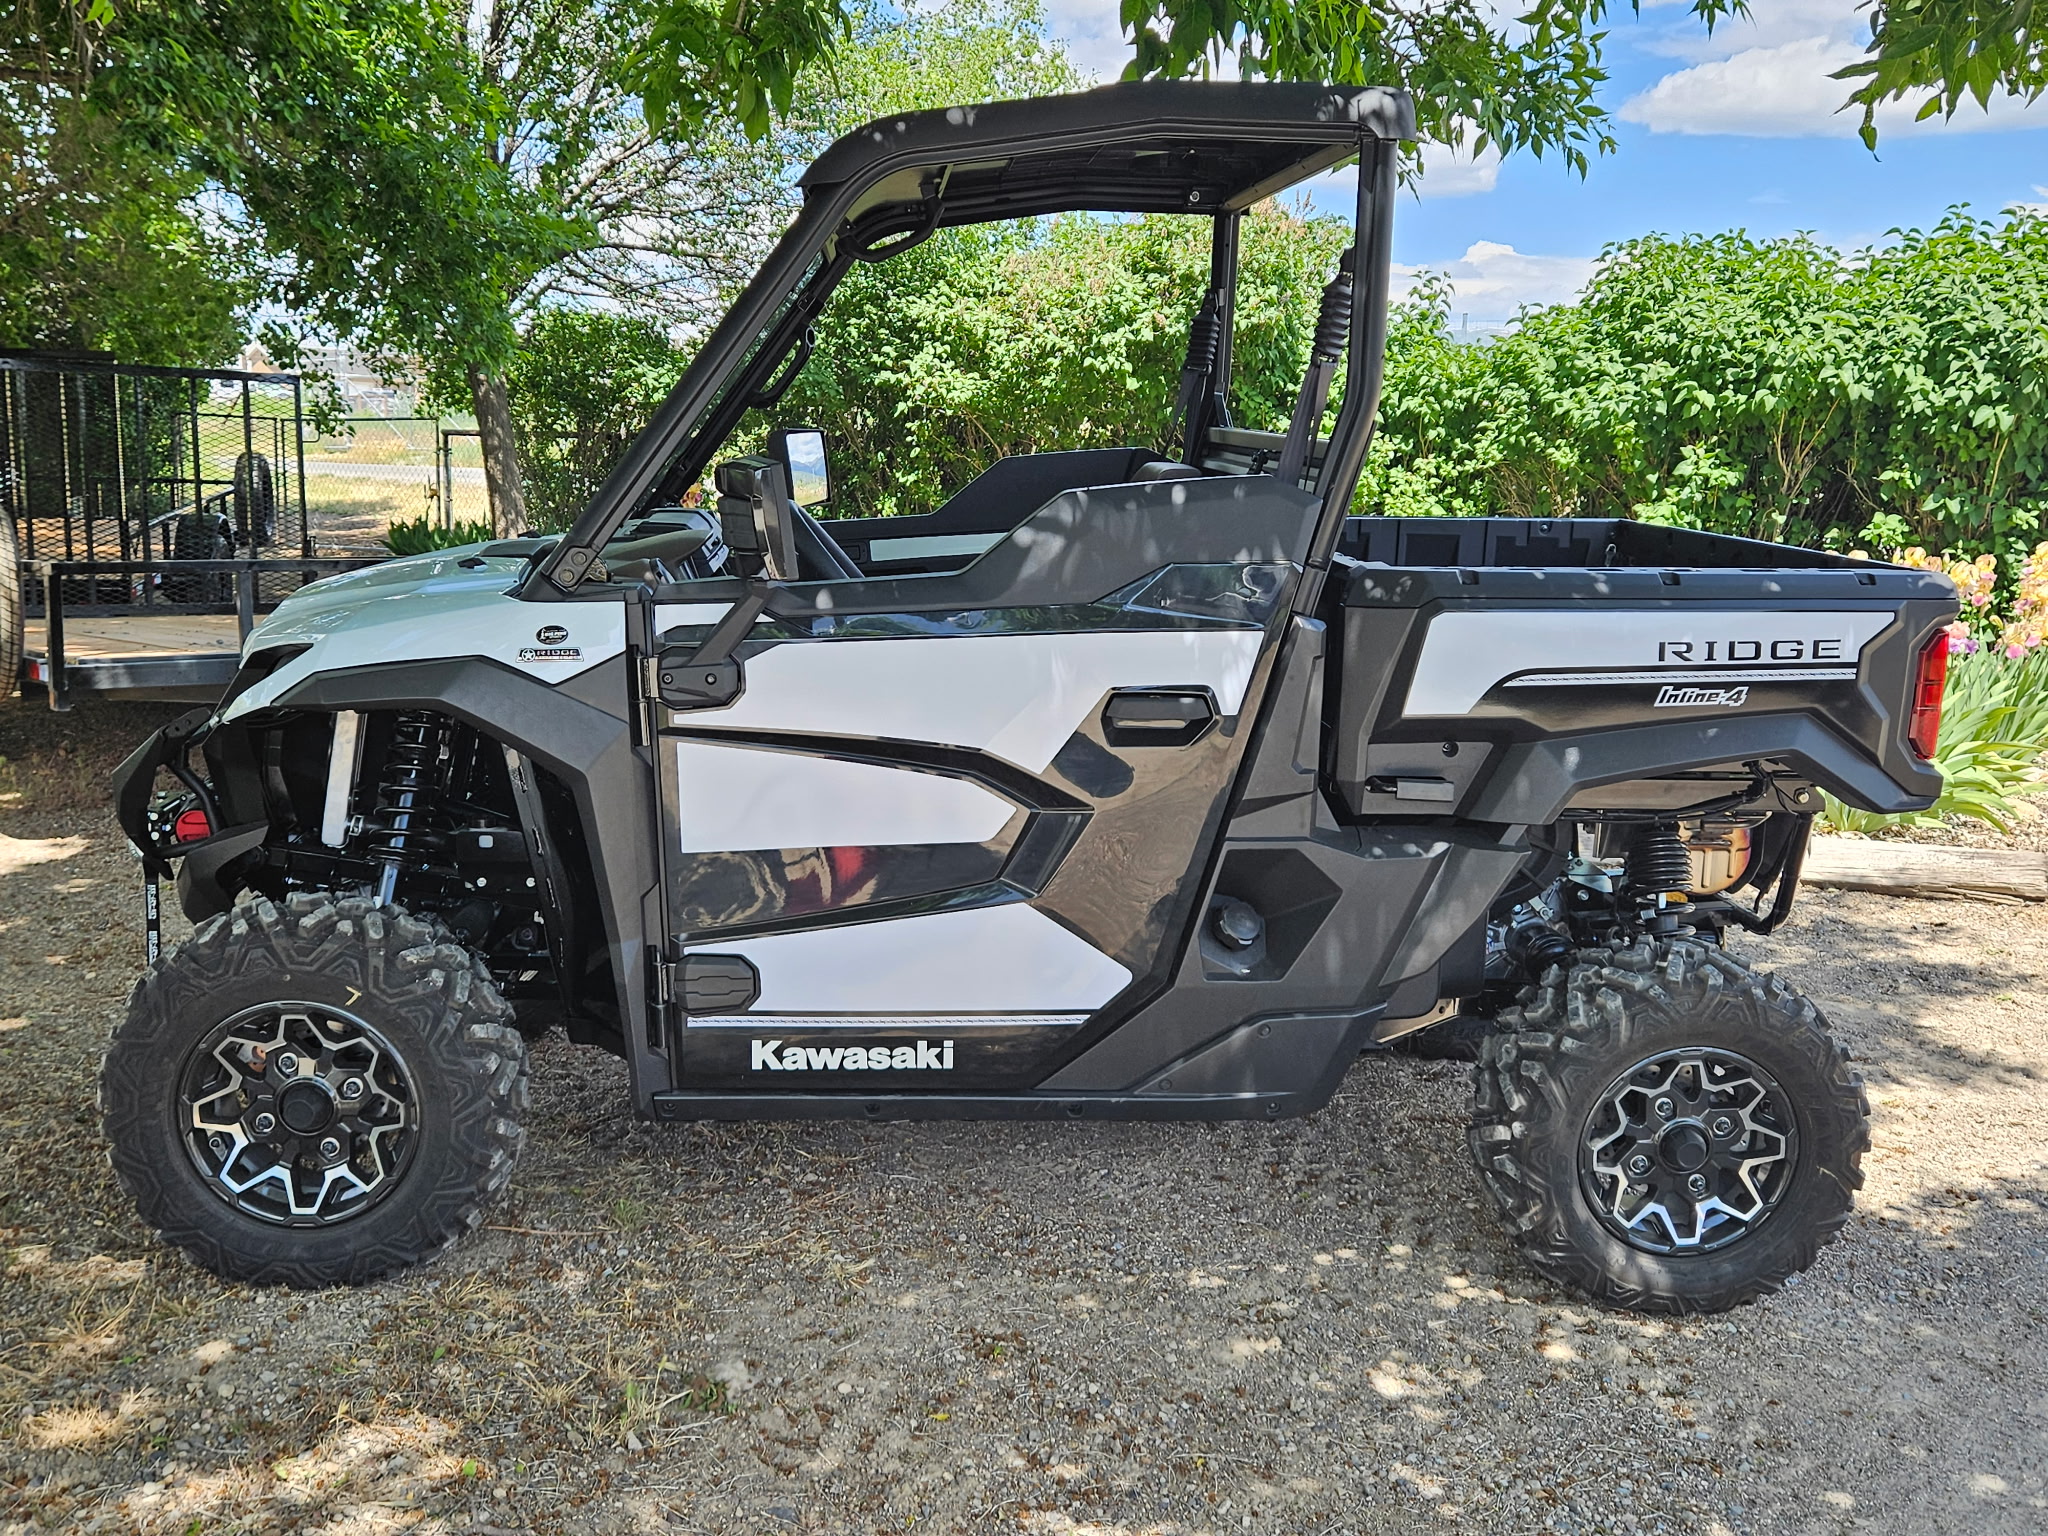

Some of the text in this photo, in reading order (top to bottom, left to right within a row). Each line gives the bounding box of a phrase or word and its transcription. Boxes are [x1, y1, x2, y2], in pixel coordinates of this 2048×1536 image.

[1658, 639, 1842, 662] RIDGE
[1654, 686, 1749, 707] Inline-4
[751, 1039, 954, 1070] Kawasaki
